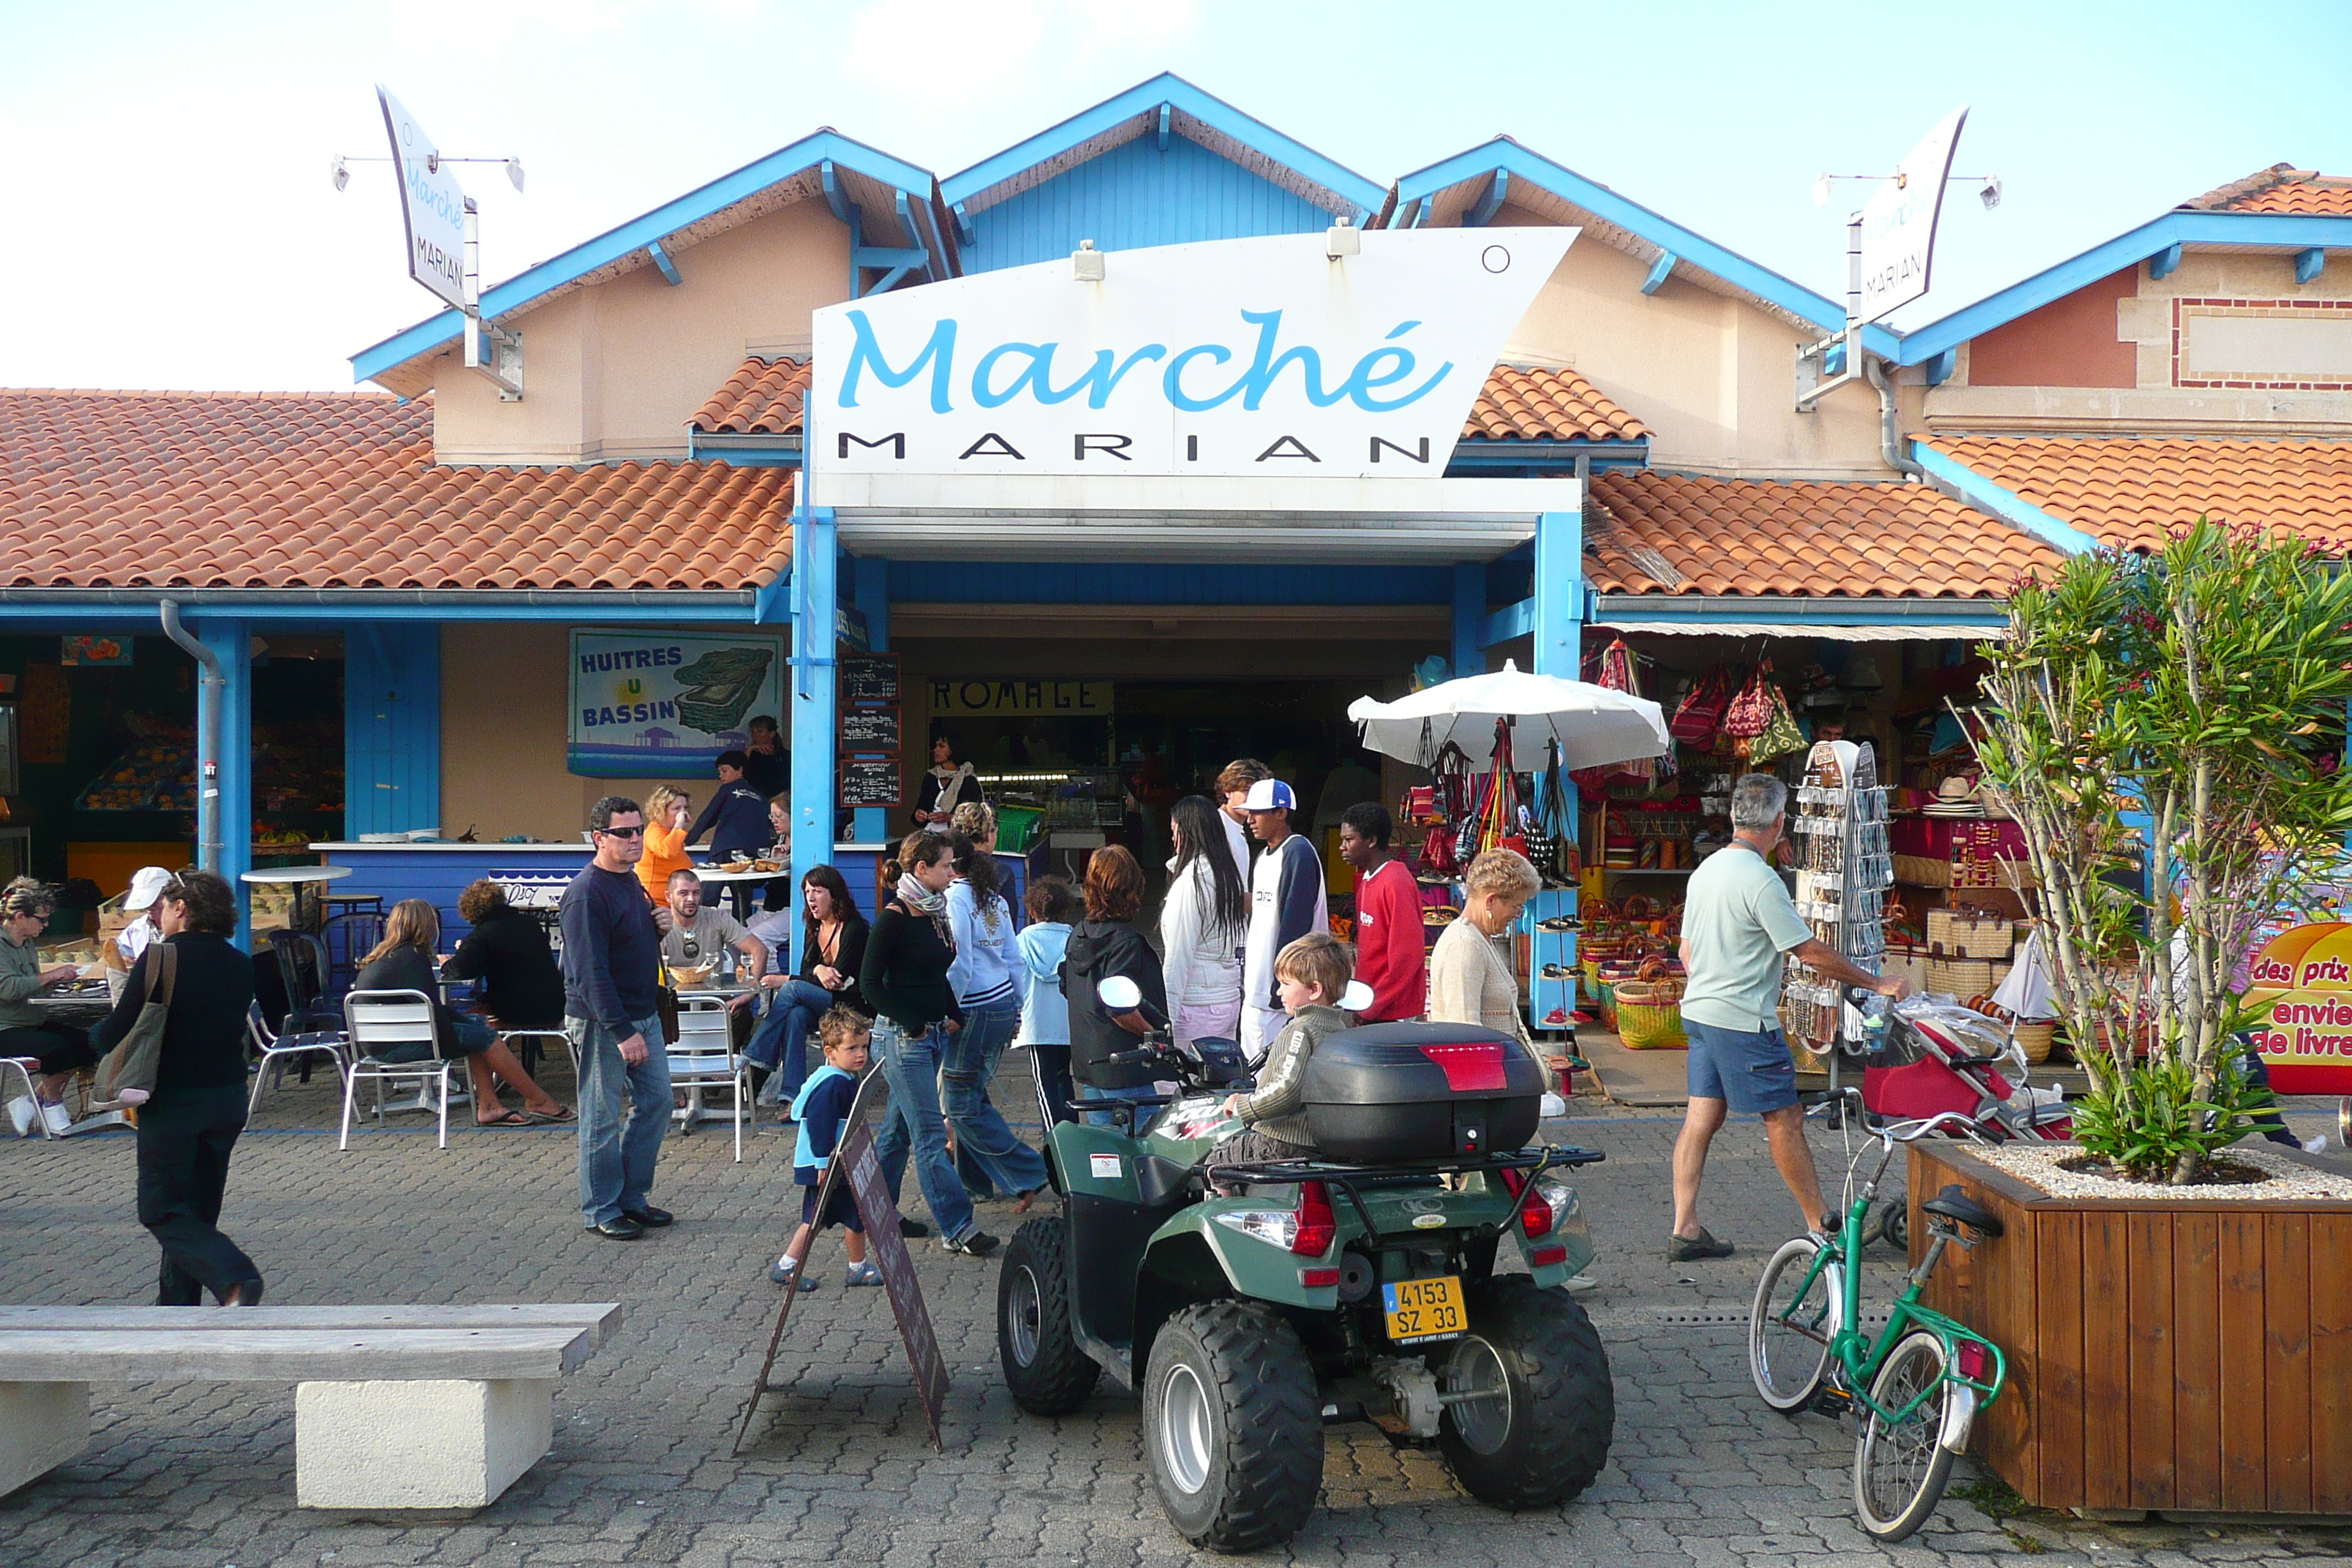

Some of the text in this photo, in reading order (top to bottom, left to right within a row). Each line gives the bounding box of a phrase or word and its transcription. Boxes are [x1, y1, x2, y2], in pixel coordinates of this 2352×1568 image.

[406, 158, 464, 230] Marché
[417, 234, 463, 290] MARIAN
[1866, 249, 1921, 302] MARIAN
[837, 308, 1455, 415] Marché
[838, 432, 1430, 464] MARIAN
[581, 646, 682, 674] HUITRES
[627, 678, 641, 694] U
[582, 700, 675, 727] BASSIN
[2253, 956, 2349, 987] des prix
[2272, 998, 2352, 1026] envie
[1289, 1030, 1305, 1055] KIDS
[2251, 1029, 2288, 1055] de
[1389, 1300, 1394, 1308] F
[1401, 1281, 1448, 1307] 4153
[1397, 1305, 1458, 1333] SZ 33
